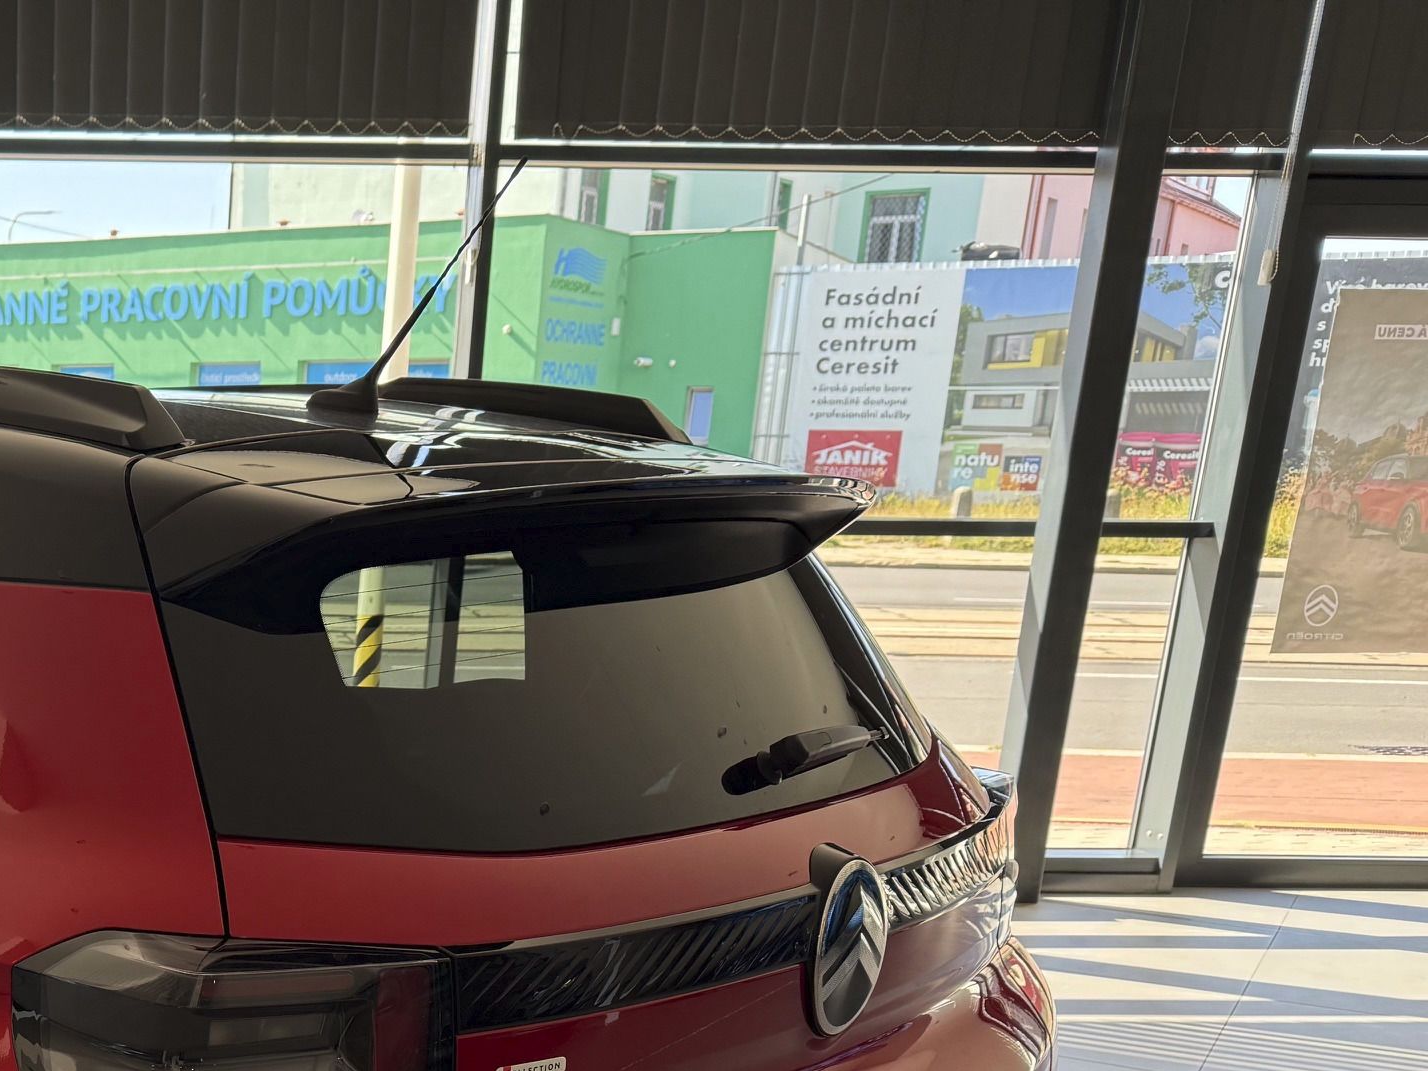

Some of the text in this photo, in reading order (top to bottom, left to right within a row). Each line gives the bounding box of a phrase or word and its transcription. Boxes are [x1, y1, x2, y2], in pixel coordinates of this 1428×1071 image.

[80, 272, 254, 323] PRACOVNÍ
[263, 264, 457, 319] POMŮKY
[825, 286, 922, 306] Fasádní
[822, 308, 938, 329] a míchací
[818, 336, 917, 352] centrum
[816, 356, 899, 375] Ceresit
[955, 452, 999, 466] natu
[1009, 459, 1039, 473] inte
